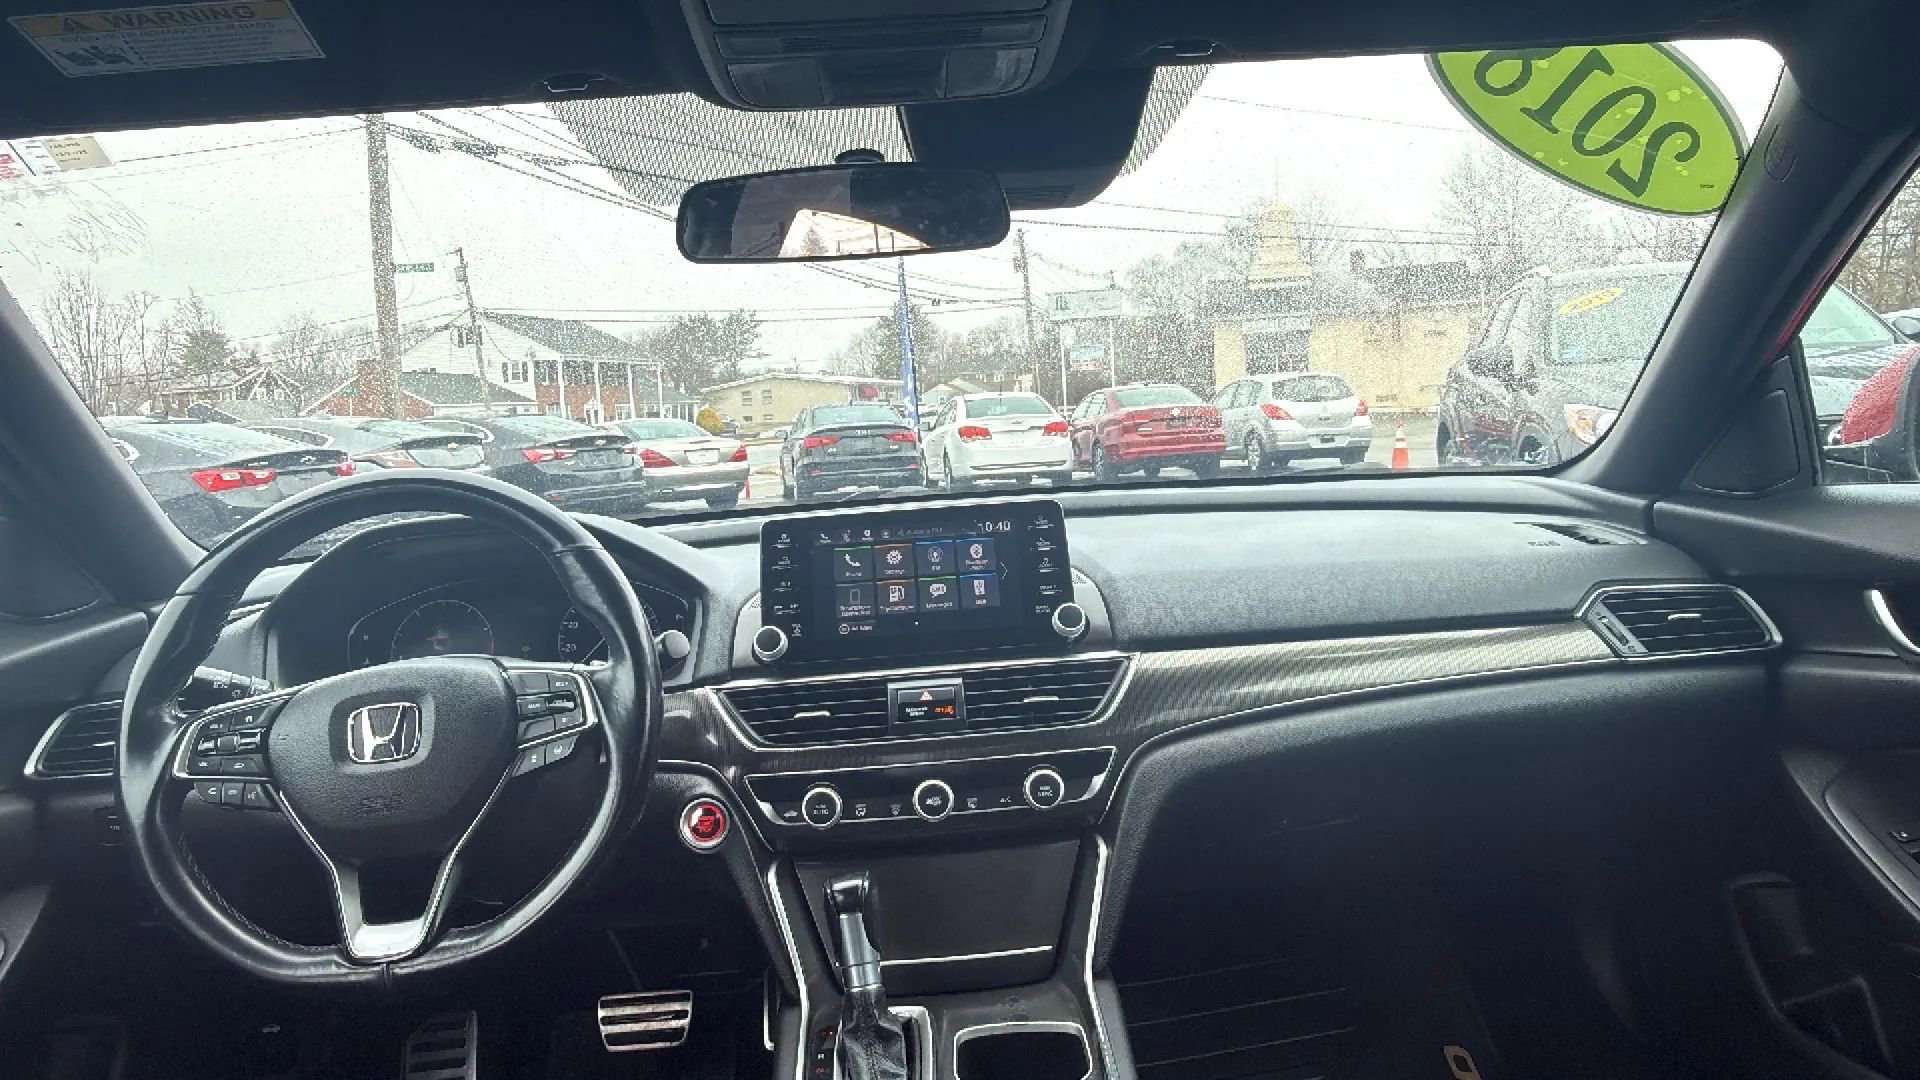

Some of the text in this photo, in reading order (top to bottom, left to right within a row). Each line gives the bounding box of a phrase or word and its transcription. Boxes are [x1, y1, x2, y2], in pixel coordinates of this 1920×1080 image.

[104, 5, 256, 27] WARNING
[977, 520, 1011, 534] 10:40
[566, 643, 577, 652] 20
